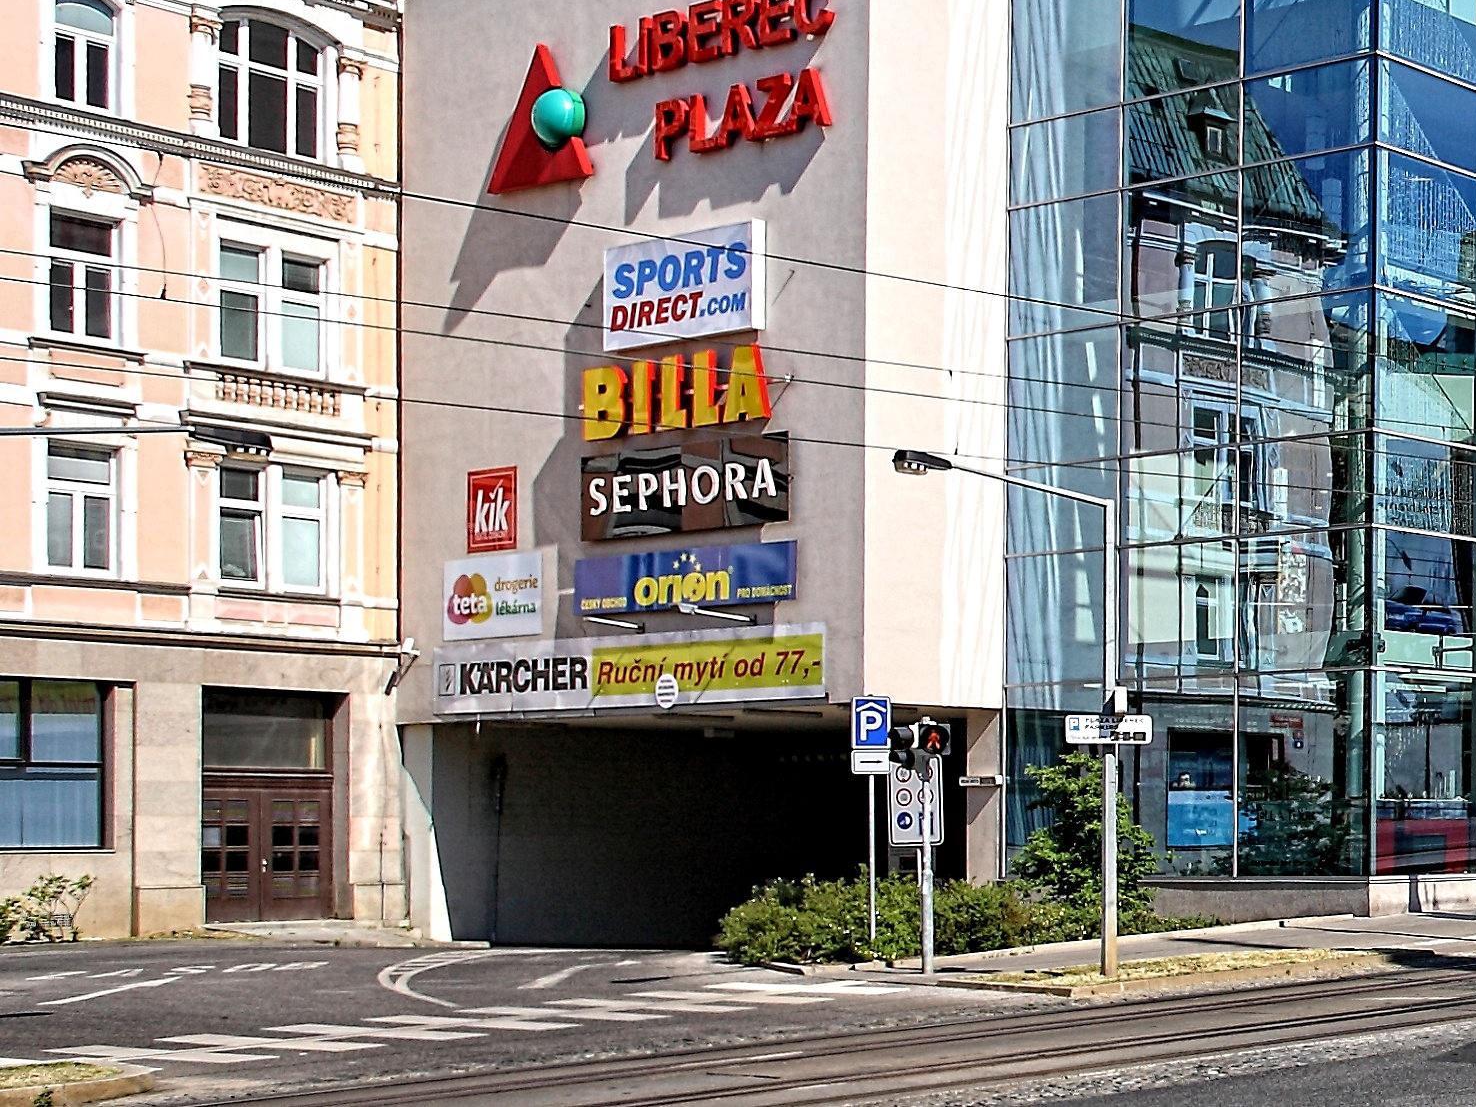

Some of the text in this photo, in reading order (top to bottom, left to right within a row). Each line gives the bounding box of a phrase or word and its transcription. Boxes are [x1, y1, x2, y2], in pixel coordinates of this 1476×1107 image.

[654, 67, 832, 162] PLAZA
[612, 241, 748, 299] SPORTS
[610, 290, 747, 333] DIRECT.COM
[583, 343, 771, 441] BILLA
[475, 479, 511, 533] kik
[588, 458, 777, 517] SEPHORA
[494, 573, 539, 595] drogerie
[634, 569, 731, 606] orion
[453, 593, 488, 616] teta
[495, 600, 537, 616] lékárna
[459, 656, 588, 696] KÄRCHER
[596, 651, 666, 686] Ruční
[673, 649, 725, 687] mytí
[733, 652, 766, 678] od
[860, 710, 883, 741] P
